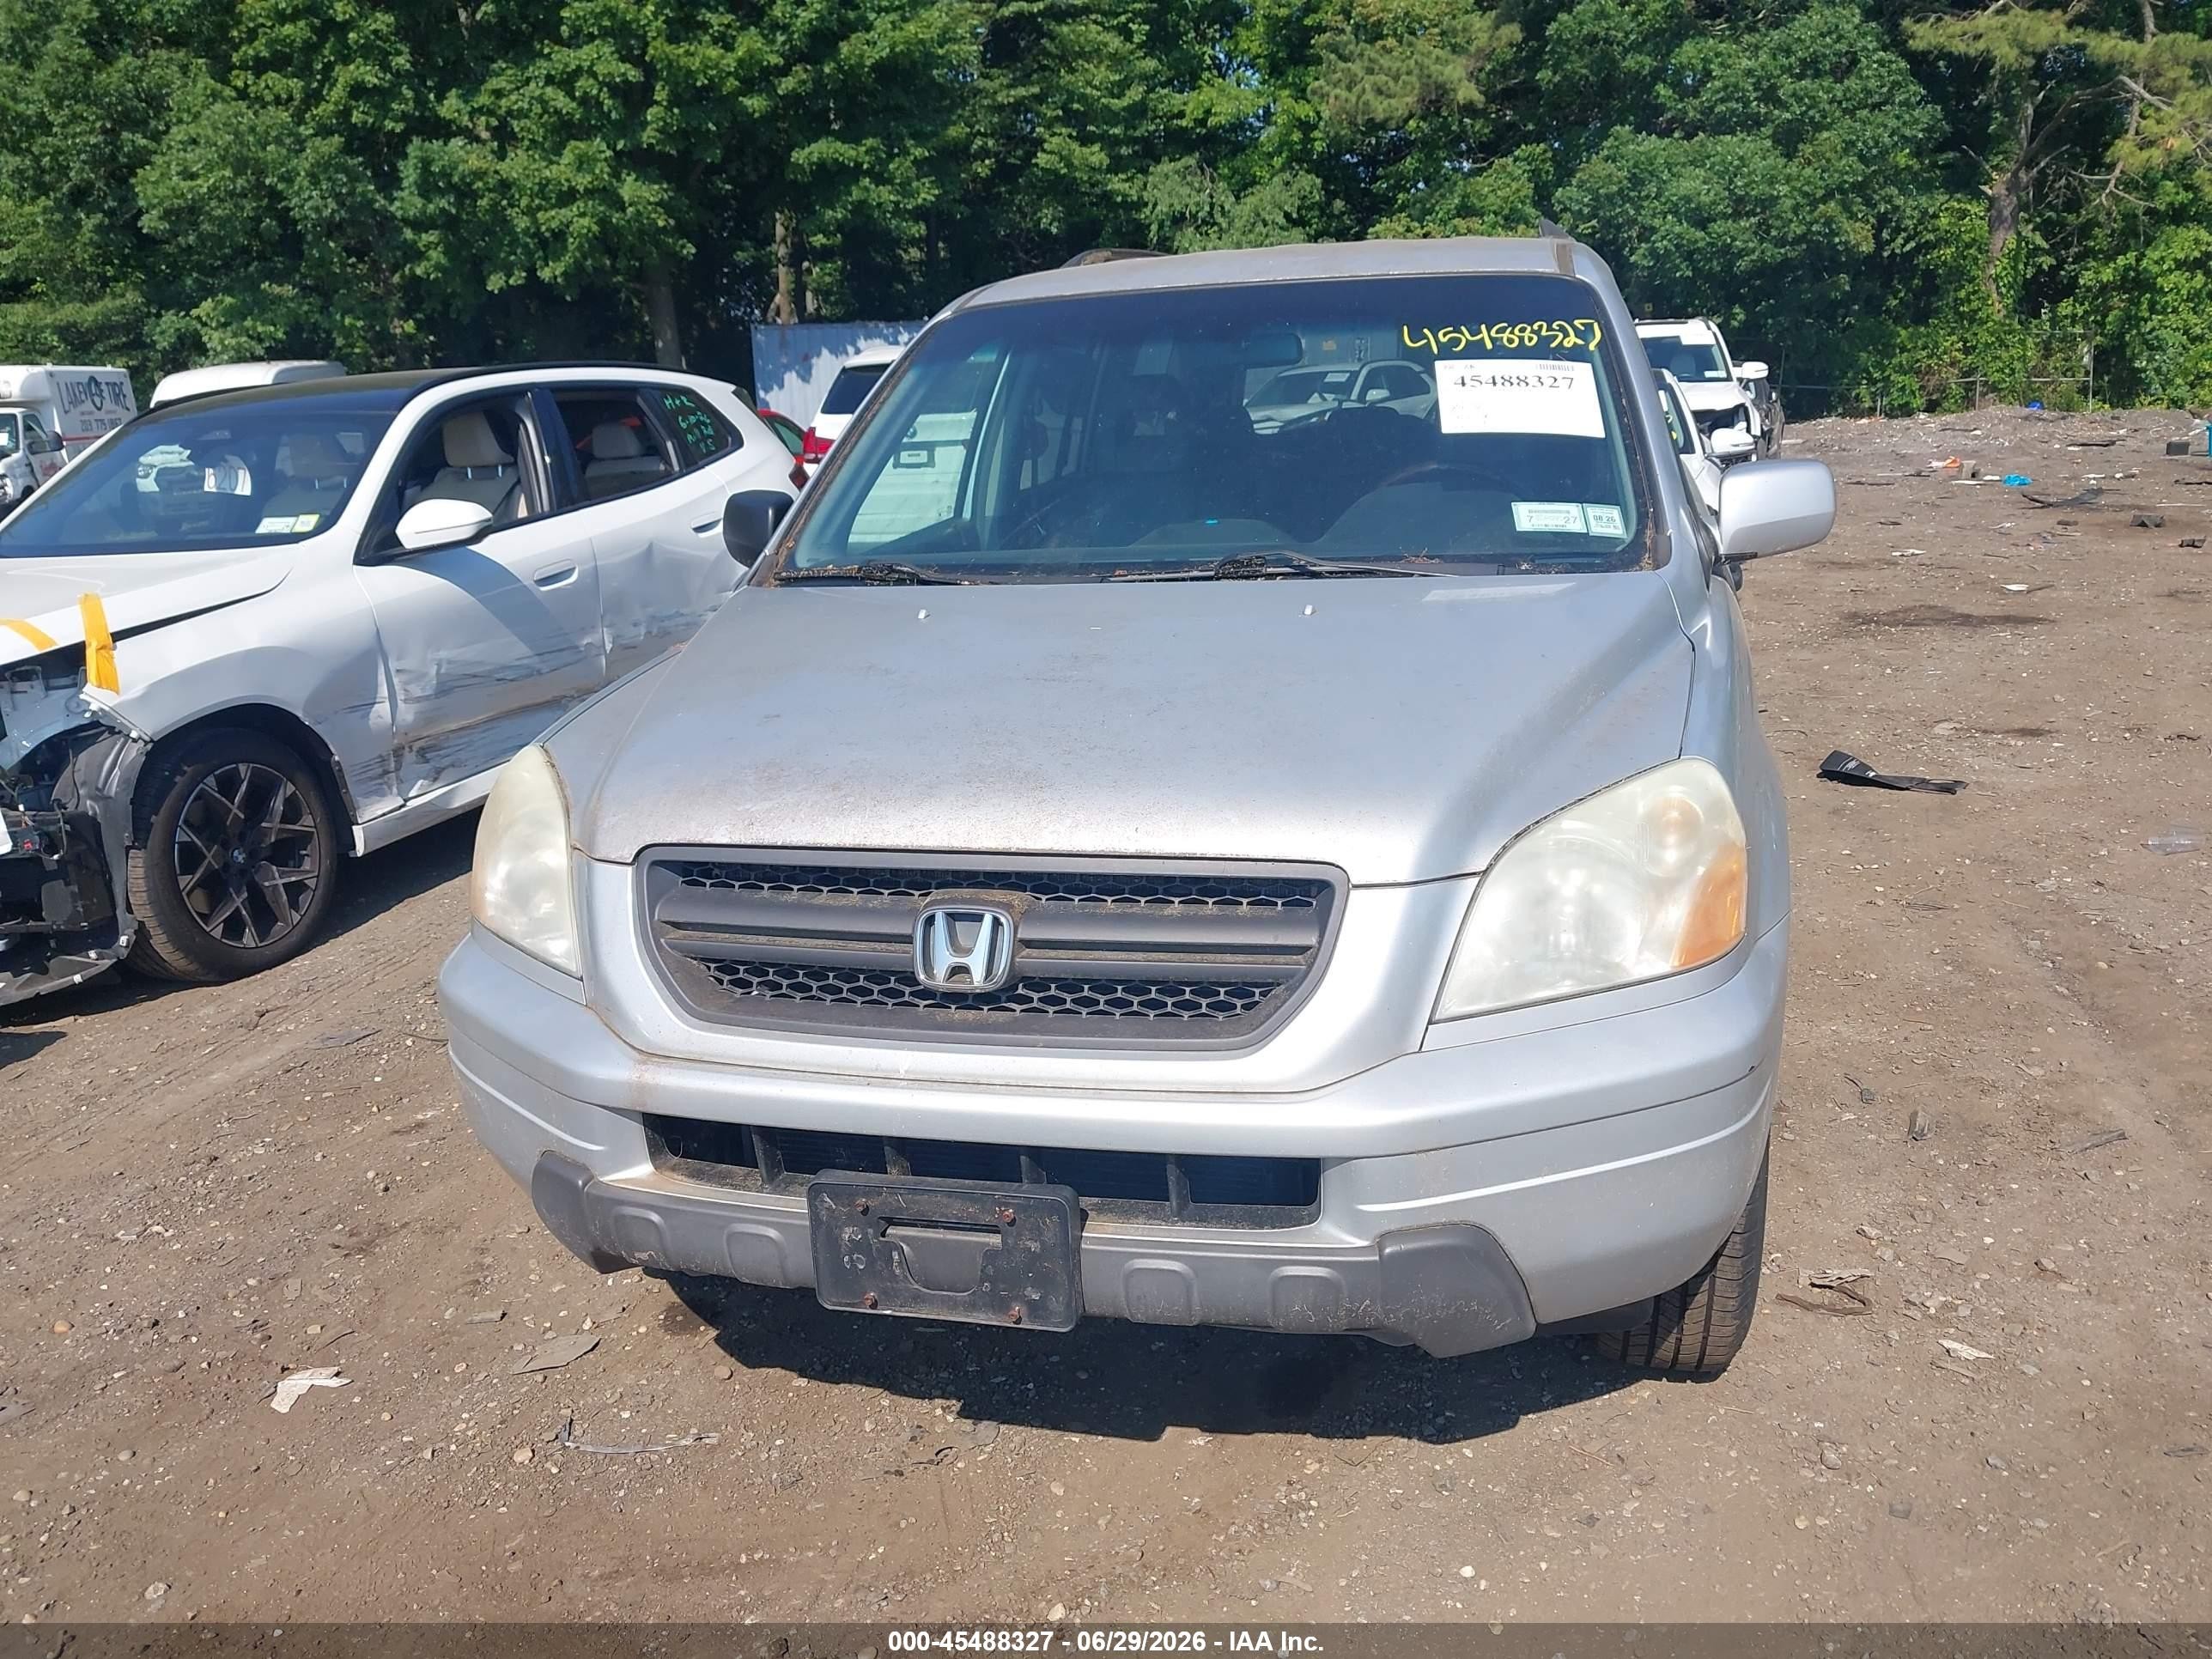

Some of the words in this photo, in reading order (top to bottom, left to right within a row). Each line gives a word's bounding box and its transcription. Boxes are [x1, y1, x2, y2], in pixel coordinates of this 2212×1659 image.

[1402, 319, 1602, 355] 45488327
[1453, 374, 1574, 390] 45488327
[106, 381, 131, 412] TIRE
[1563, 515, 1578, 524] 27
